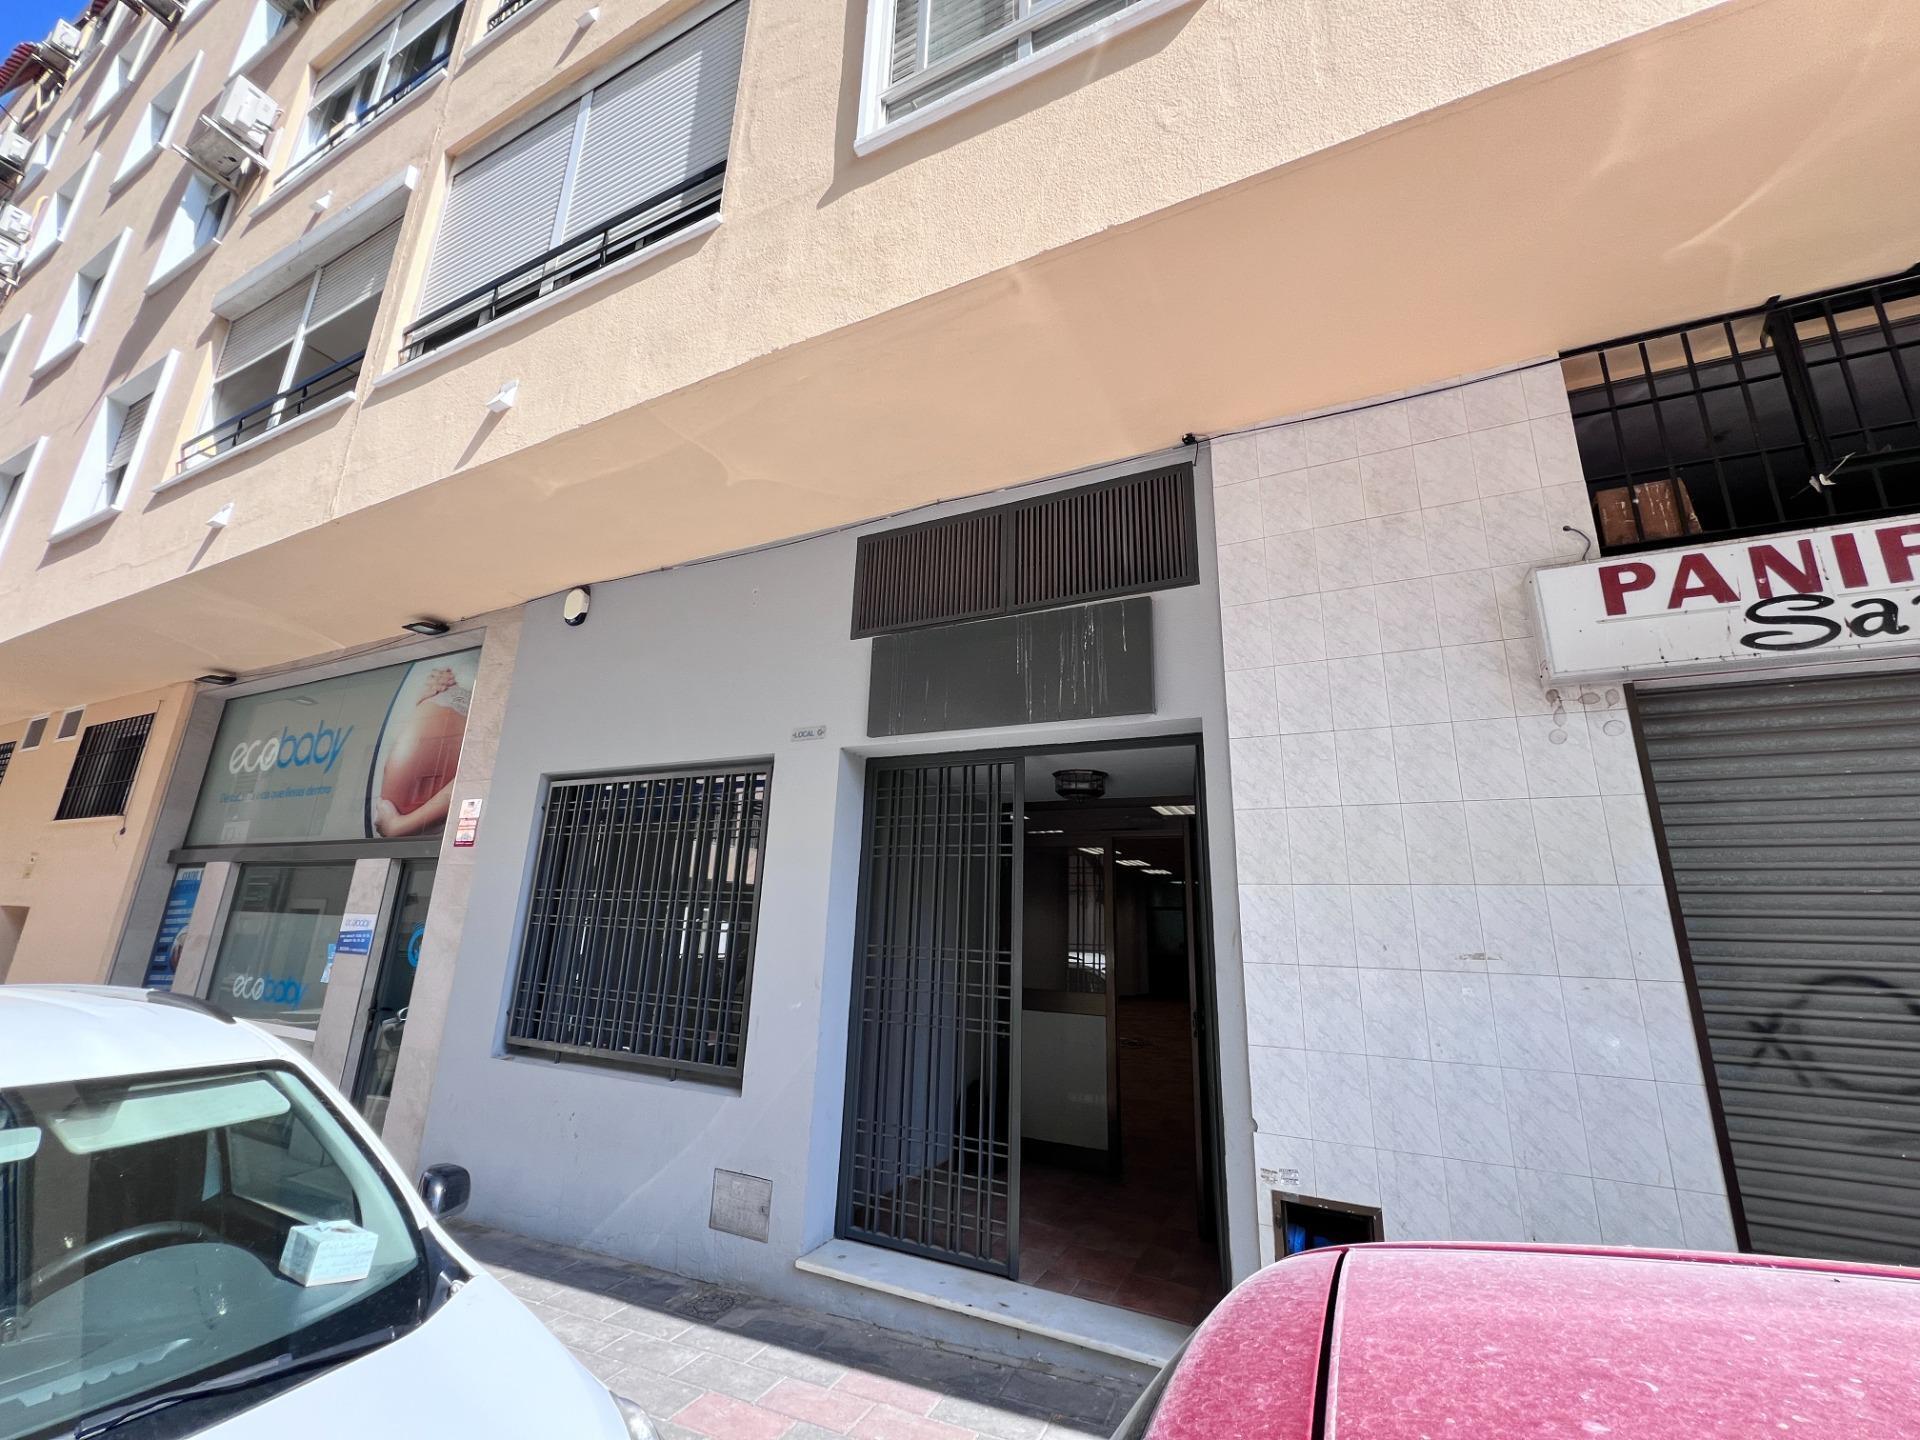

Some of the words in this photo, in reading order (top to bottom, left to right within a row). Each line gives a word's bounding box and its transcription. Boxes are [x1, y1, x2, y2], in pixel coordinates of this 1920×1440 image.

[1740, 594, 1920, 650] Sa
[229, 720, 354, 774] ecobaby
[232, 971, 309, 1010] ecobaby
